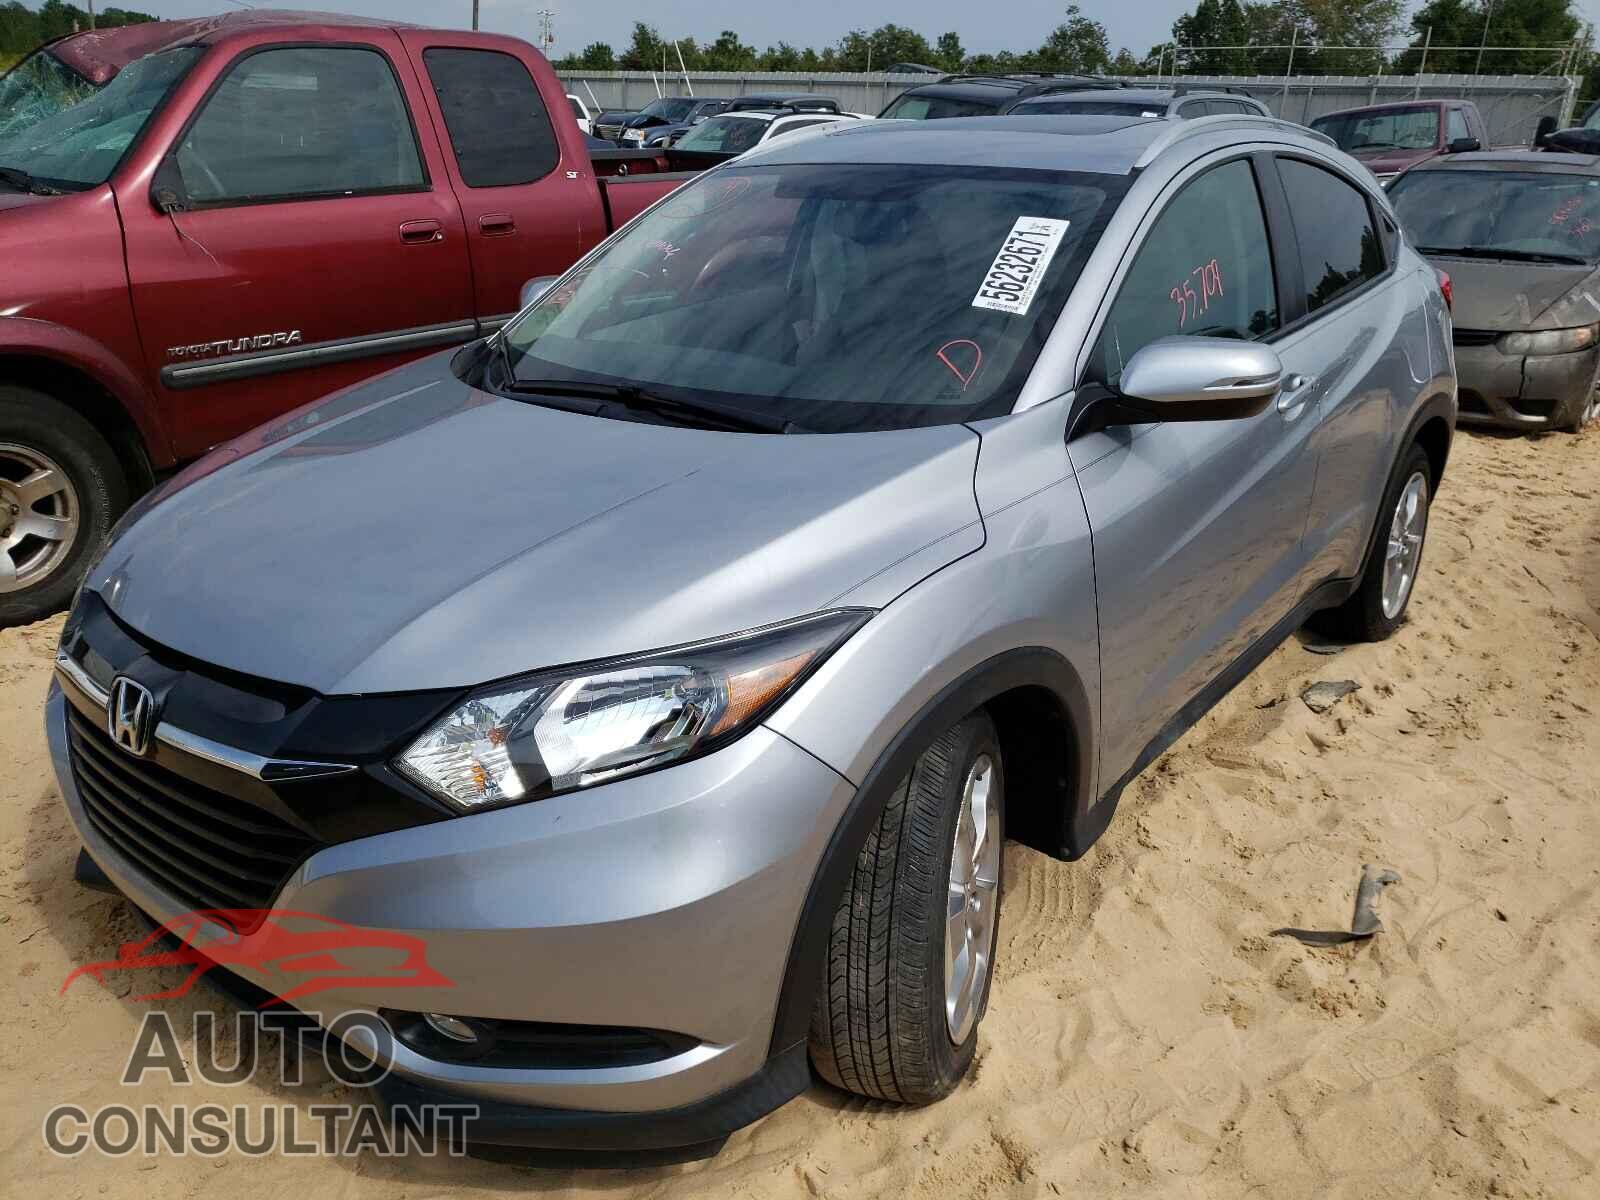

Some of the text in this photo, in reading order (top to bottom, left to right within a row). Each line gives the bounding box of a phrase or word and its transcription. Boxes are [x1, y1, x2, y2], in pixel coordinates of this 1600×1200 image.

[980, 230, 1051, 302] 56232671
[167, 330, 302, 357] TOYOTA TUNDRA
